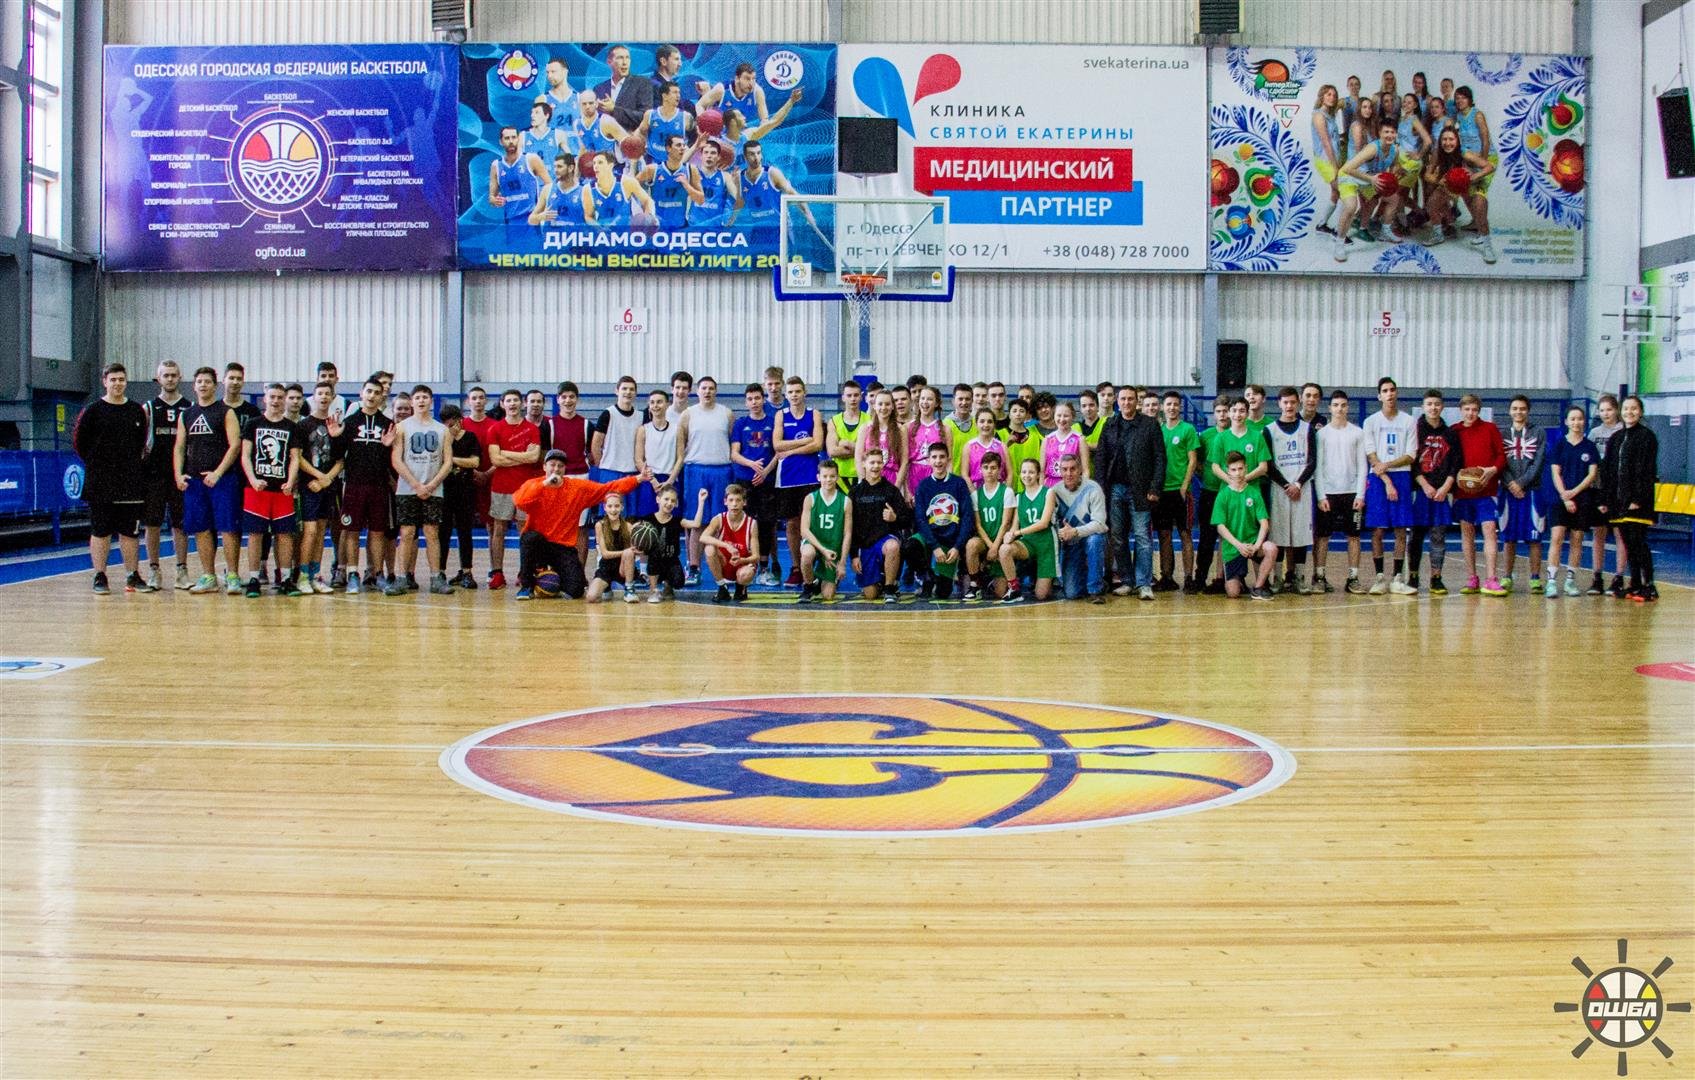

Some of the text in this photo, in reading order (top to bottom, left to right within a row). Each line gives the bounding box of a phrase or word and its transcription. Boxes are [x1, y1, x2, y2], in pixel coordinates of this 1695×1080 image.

[1083, 56, 1190, 70] svekaterina.ua
[134, 60, 428, 78] ОДЕССКАЯ ГОРОДСКАЯ ФЕДЕРАЦИЯ БАСКЕТБОЛА
[264, 93, 298, 101] БАСКЕТБОЛ
[179, 104, 238, 112] ДЕТСКИЙ БАСКЕТБОЛ
[326, 108, 389, 116] ЖЕНСКИЙ БАСКЕТБОЛ
[930, 104, 1025, 117] КЛИНИКА
[556, 114, 573, 127] 24
[130, 129, 208, 137] СТУДЕНЧЕСКИЙ БАСКЕТБОЛ
[930, 124, 1134, 140] СВЯТОЙ ЕКАТЕРИНЫ
[347, 138, 381, 146] БАСКЕТБОЛ
[149, 153, 211, 162] ЛЮБИТЕЛЬСКИЕ ЛИГИ
[340, 154, 414, 162] ВЕТЕРАНСКИЙ БАСКЕТБОЛ
[168, 162, 192, 170] ГОРОДА
[930, 157, 1114, 182] МЕДИЦИНСКИЙ
[367, 170, 401, 178] БАСКЕТБОЛ
[151, 182, 187, 190] МЕМОРИАЛЫ
[353, 177, 424, 186] ИНВАЛИДНЫХ КОЛЯСКАХ
[143, 197, 182, 206] СПОРТИВНЫЙ
[340, 194, 390, 202] МАСТЕР-КЛАССЫ
[337, 203, 363, 211] ДЕТСКИЕ
[363, 202, 398, 210] ПРАЗДНИКИ
[1001, 196, 1113, 217] ПАРТНЕР
[148, 223, 167, 231] СВЯЗИ
[173, 222, 230, 231] ОБЩЕСТВЕННОСТЬЮ
[324, 222, 377, 230] ВОССТАНОВЛЕНИЕ
[382, 221, 430, 229] СТРОИТЕЛЬСТВО
[165, 230, 219, 239] СМИ-ПАРТНЕРСТВО
[345, 229, 408, 238] УЛИЧНЫХ ПЛОЩАДОК
[543, 231, 749, 251] ДИНАМО ОДЕССА
[255, 246, 306, 260] ogfb.od.ua
[972, 244, 1009, 258] 12/1
[1042, 245, 1071, 258] +38
[1074, 244, 1116, 260] (048)
[1120, 245, 1148, 258] 728
[1152, 245, 1190, 258] 7000
[488, 250, 804, 268] ЧЕМПИОНЫ ВЫСШЕЙ ЛИГИ 208
[623, 308, 633, 324] 6
[1382, 311, 1392, 327] 5
[613, 324, 643, 332] СЕКТОР
[1372, 327, 1401, 335] СЕКТОР
[167, 409, 175, 422] 5
[1387, 433, 1396, 444] 11
[1286, 440, 1297, 451] 29
[982, 506, 997, 523] 10
[1025, 507, 1040, 523] 12
[818, 513, 834, 529] 15
